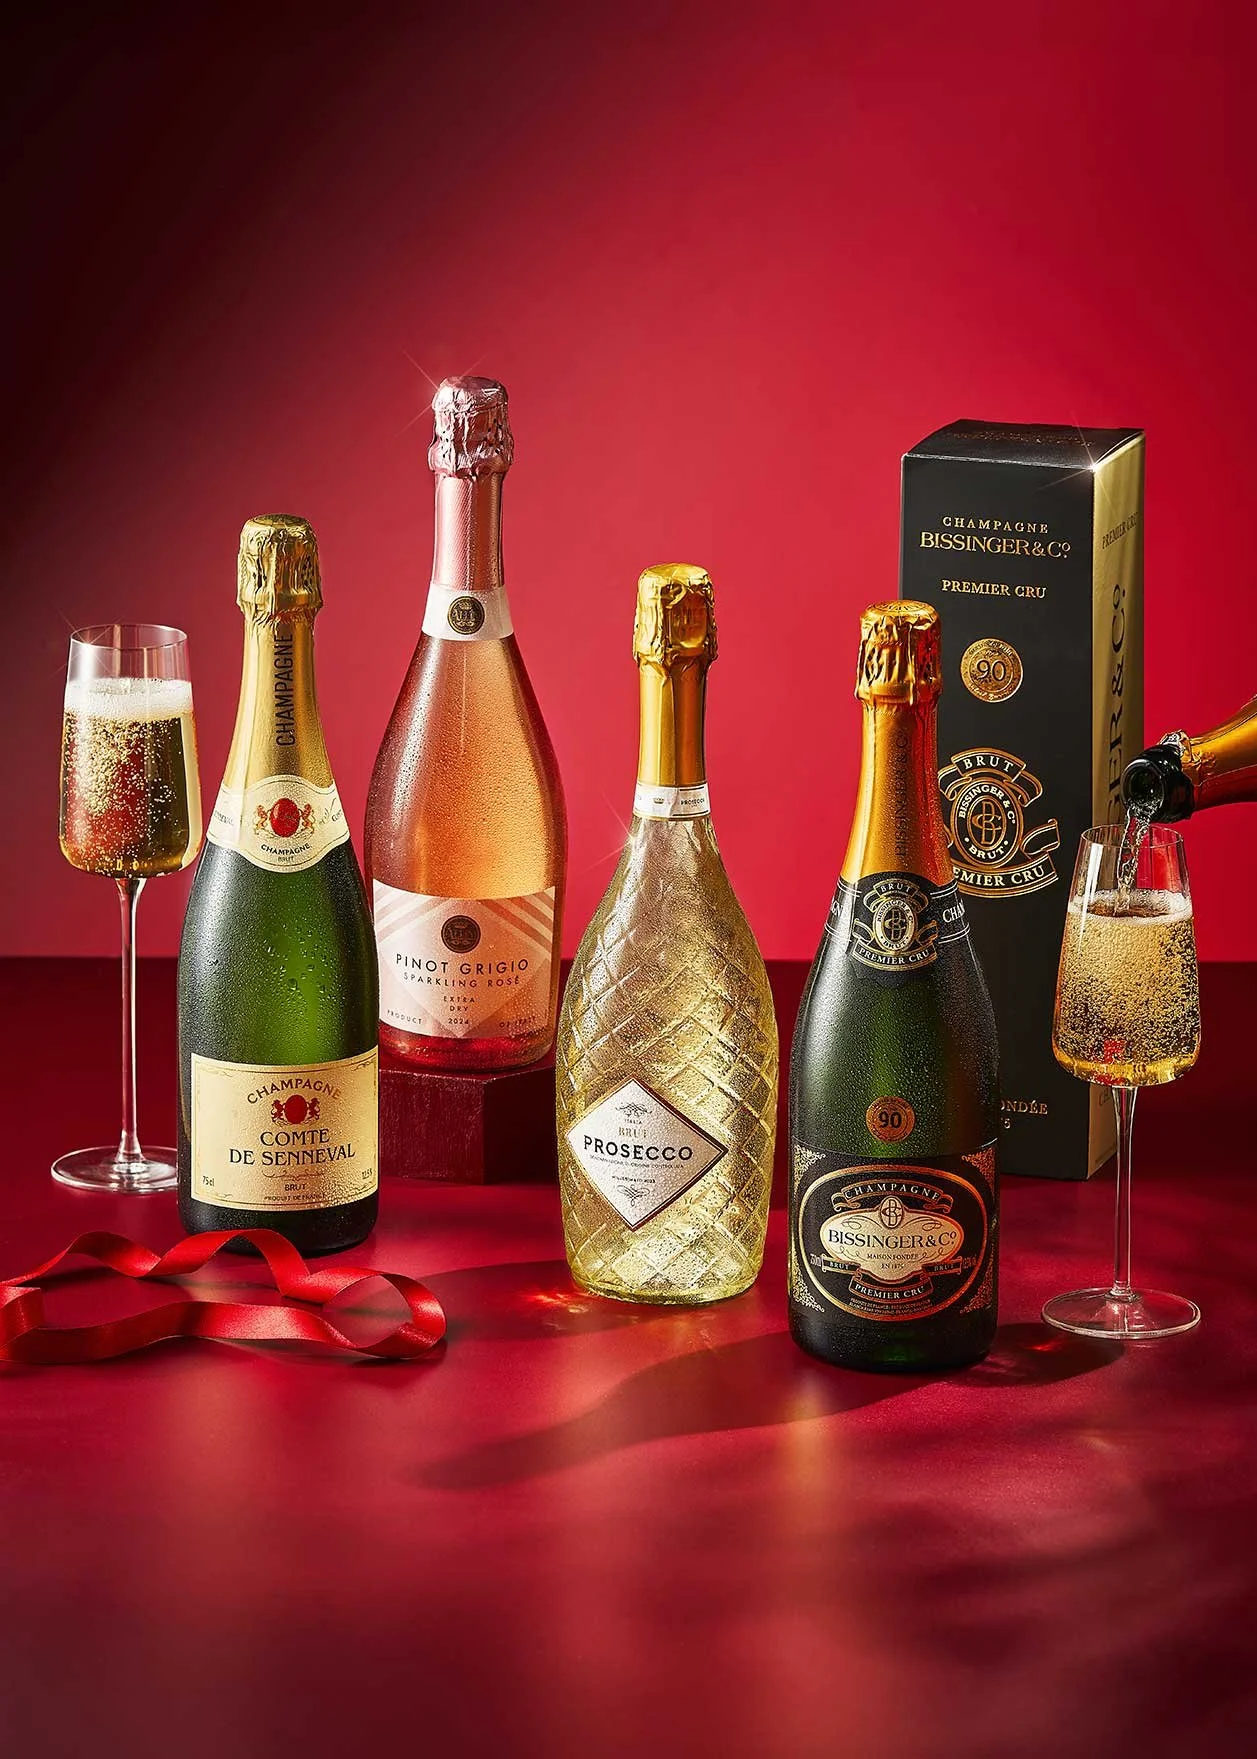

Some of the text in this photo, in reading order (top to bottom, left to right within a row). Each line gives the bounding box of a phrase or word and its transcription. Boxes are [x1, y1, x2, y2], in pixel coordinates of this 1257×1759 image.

[942, 516, 1049, 534] CHAMPAGNE
[941, 579, 1047, 599] PREMIER CRU
[976, 658, 1006, 682] 90
[274, 633, 295, 746] CHAMPAGNE
[962, 755, 1014, 773] BRUT
[958, 784, 1005, 819] BISSINGER
[1002, 800, 1010, 809] &
[260, 842, 311, 855] CHAMPAGNE
[968, 845, 1005, 860] BRUT
[1010, 865, 1045, 885] CRU
[880, 882, 912, 893] BRUT
[395, 953, 529, 975] PINOT GRIGIO
[858, 948, 930, 965] PREMIER CRU
[403, 972, 520, 988] SPARKLING ROSÉ
[443, 995, 475, 1003] EXTRA
[387, 1009, 422, 1024] PRODUCT
[447, 1017, 470, 1025] 2024
[247, 1078, 343, 1104] CHAMPAGNE
[878, 1111, 902, 1128] 90
[260, 1128, 330, 1146] COMTE
[229, 1143, 356, 1166] DE SENNEVAL
[583, 1134, 693, 1161] PROSECCO
[202, 1175, 215, 1187] 75cl
[284, 1183, 306, 1192] BRUT
[844, 1182, 940, 1201] CHAMPAGNE
[829, 1261, 850, 1270] BRUT
[854, 1283, 926, 1299] PREMIER CRU
